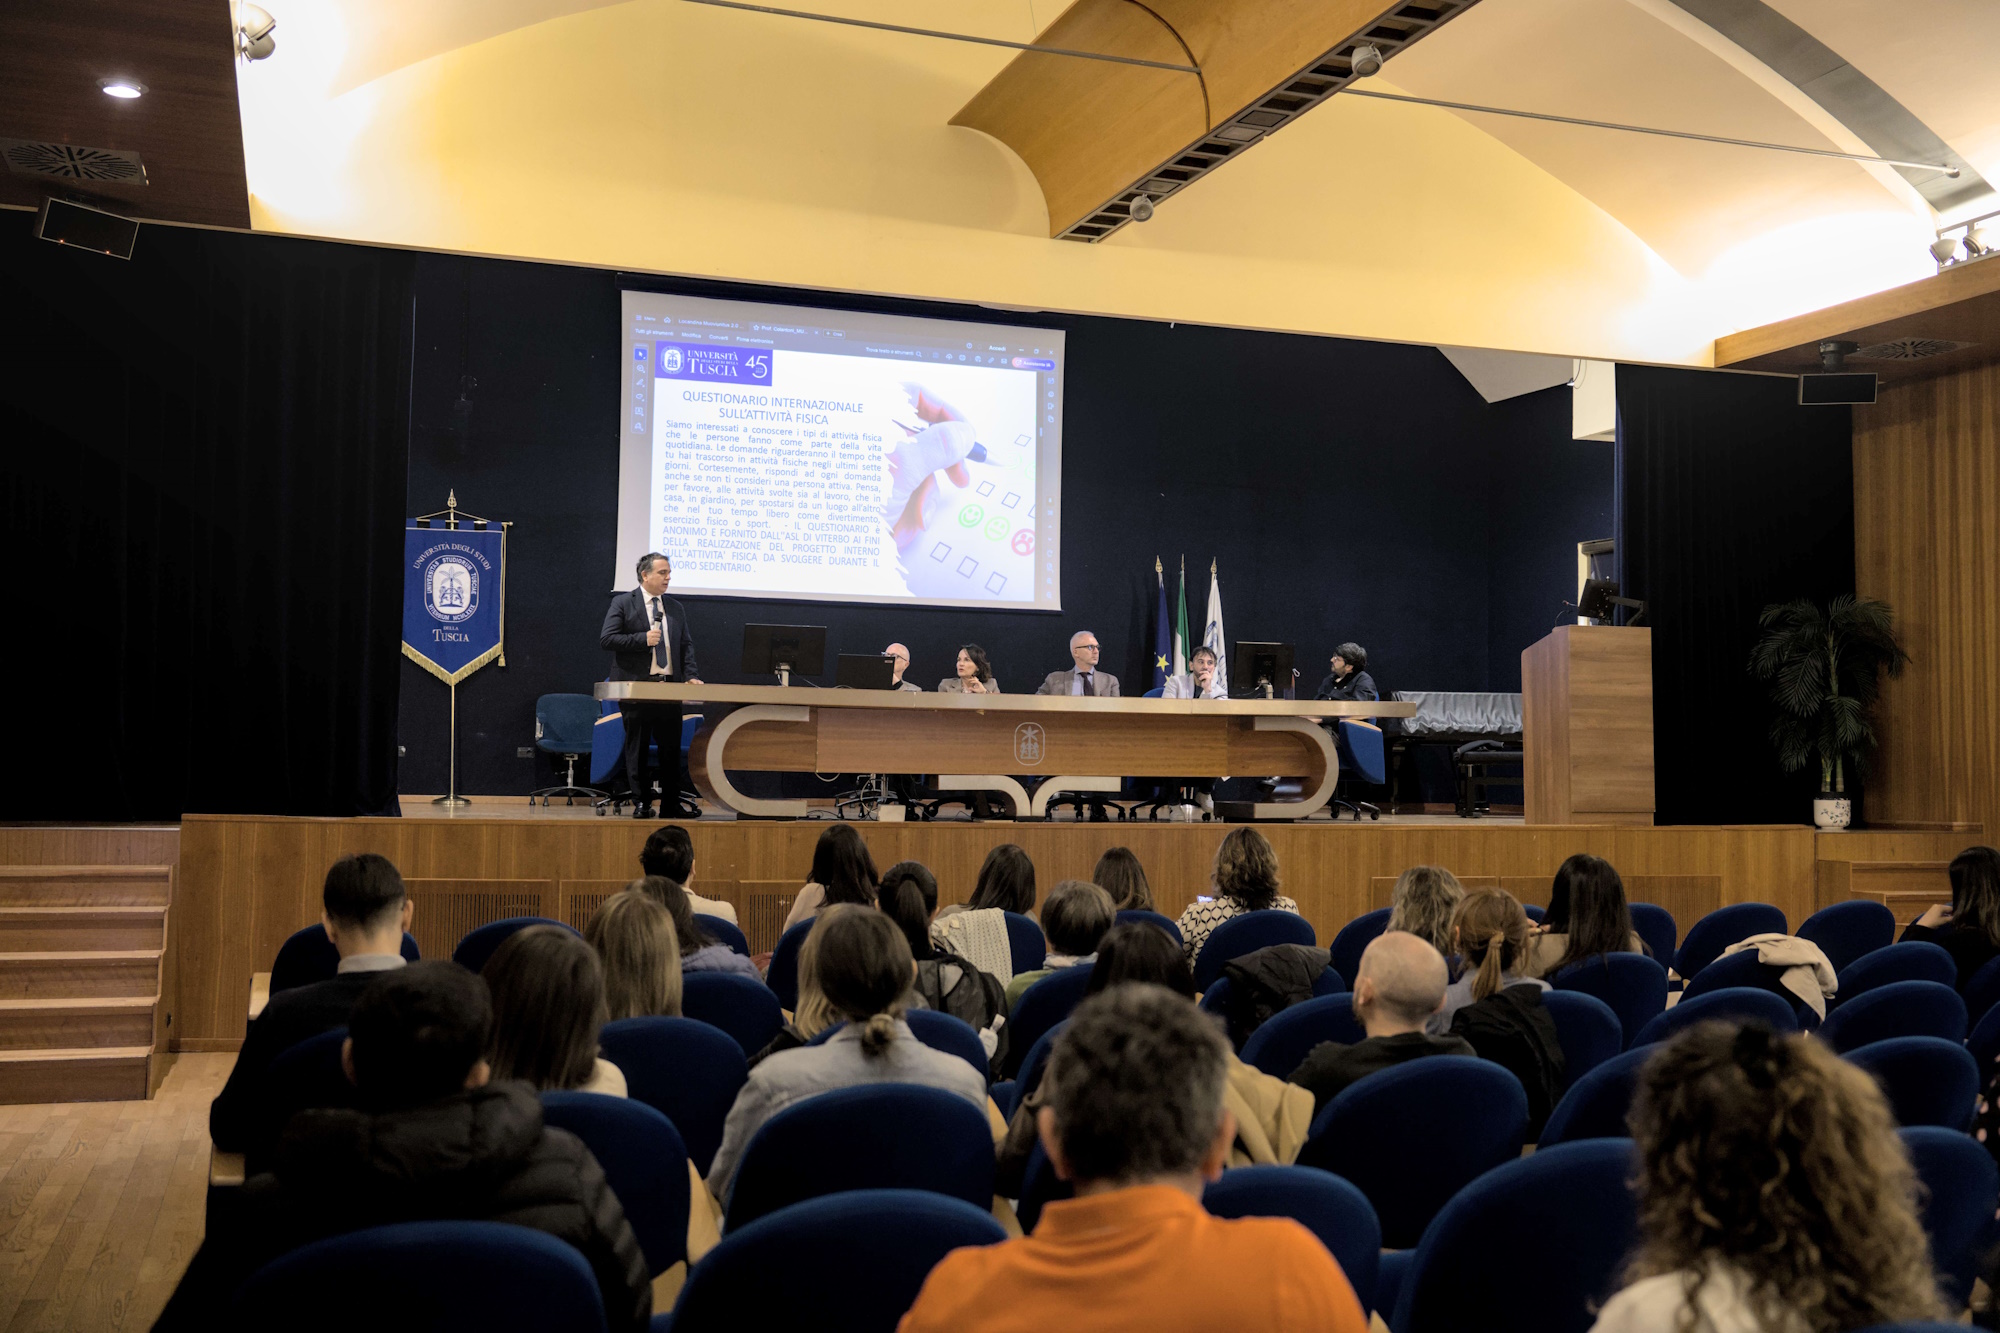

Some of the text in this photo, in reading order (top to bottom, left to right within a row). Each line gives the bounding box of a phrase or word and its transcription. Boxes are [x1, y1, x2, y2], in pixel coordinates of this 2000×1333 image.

[688, 350, 738, 361] UNIVERSITÀ
[687, 358, 738, 376] TUSCIA
[745, 355, 768, 378] 45
[683, 391, 863, 413] QUESTIONARIO INTERNAZIONALE
[719, 408, 828, 425] SULL'ATTIVITÀ FISICA
[666, 420, 692, 429] Siamo
[696, 422, 738, 432] interessati
[752, 427, 792, 436] conoscere
[804, 430, 816, 438] tipi
[832, 432, 858, 440] attività
[862, 433, 882, 442] fisica
[666, 430, 680, 438] che
[690, 432, 697, 440] le
[706, 434, 739, 442] persone
[749, 435, 772, 444] fanno
[841, 442, 859, 450] della
[666, 441, 712, 451] quotidiana.
[729, 444, 768, 454] domande
[772, 447, 828, 458] riguarderanno
[839, 452, 864, 461] tempo
[679, 451, 691, 460] hai
[696, 453, 733, 462] trascorso
[738, 455, 745, 463] in
[750, 456, 778, 465] attività
[783, 458, 808, 466] fisiche
[812, 461, 831, 469] negli
[836, 461, 858, 470] ultimi
[665, 461, 691, 471] giorni.
[698, 463, 758, 475] Cortesemente,
[766, 467, 798, 476] rispondi
[821, 471, 838, 480] ogni
[844, 472, 881, 482] domanda
[683, 483, 711, 494] favore,
[717, 485, 731, 494] alle
[736, 487, 764, 496] attività
[769, 488, 793, 497] svolte
[798, 490, 808, 498] sia
[813, 491, 819, 499] al
[824, 491, 850, 501] lavoro,
[874, 494, 880, 502] in
[726, 475, 730, 483] ti
[734, 477, 771, 485] consideri
[828, 482, 852, 490] attiva.
[856, 483, 880, 493] Pensa,
[664, 494, 684, 503] casa,
[689, 494, 696, 502] in
[701, 495, 736, 506] giardino,
[759, 500, 794, 508] spostarsi
[798, 500, 807, 509] da
[826, 502, 848, 512] luogo
[664, 504, 678, 512] che
[687, 505, 700, 513] nel
[731, 508, 758, 517] tempo
[766, 509, 789, 518] libero
[828, 513, 880, 524] divertimento,
[664, 516, 700, 524] esercizio
[707, 516, 728, 526] fisico
[747, 520, 770, 529] sport.
[794, 522, 801, 530] IL
[808, 522, 869, 533] QUESTIONARIO
[876, 525, 880, 534] è
[663, 526, 707, 536] ANONIMO
[712, 528, 716, 537] E
[720, 529, 757, 538] FORNITO
[804, 533, 811, 541] DI
[815, 534, 850, 543] VITERBO
[865, 536, 880, 544] FINI
[413, 542, 491, 570] UNIVERSITÀ DEGLI STUDI
[663, 537, 880, 556] DELLA REALIZZAZIONE DEL PROGETTO INTERNO
[668, 560, 697, 570] VORO
[699, 562, 751, 572] SEDENTARIO
[732, 552, 757, 561] FISICA
[764, 553, 775, 562] DA
[781, 554, 822, 564] SVOLGERE
[829, 557, 867, 566] DURANTE
[873, 559, 879, 567] IL
[427, 560, 439, 594] UNIVERSITAS
[442, 558, 473, 571] STUDIORUM
[432, 629, 469, 642] TUSCIA
